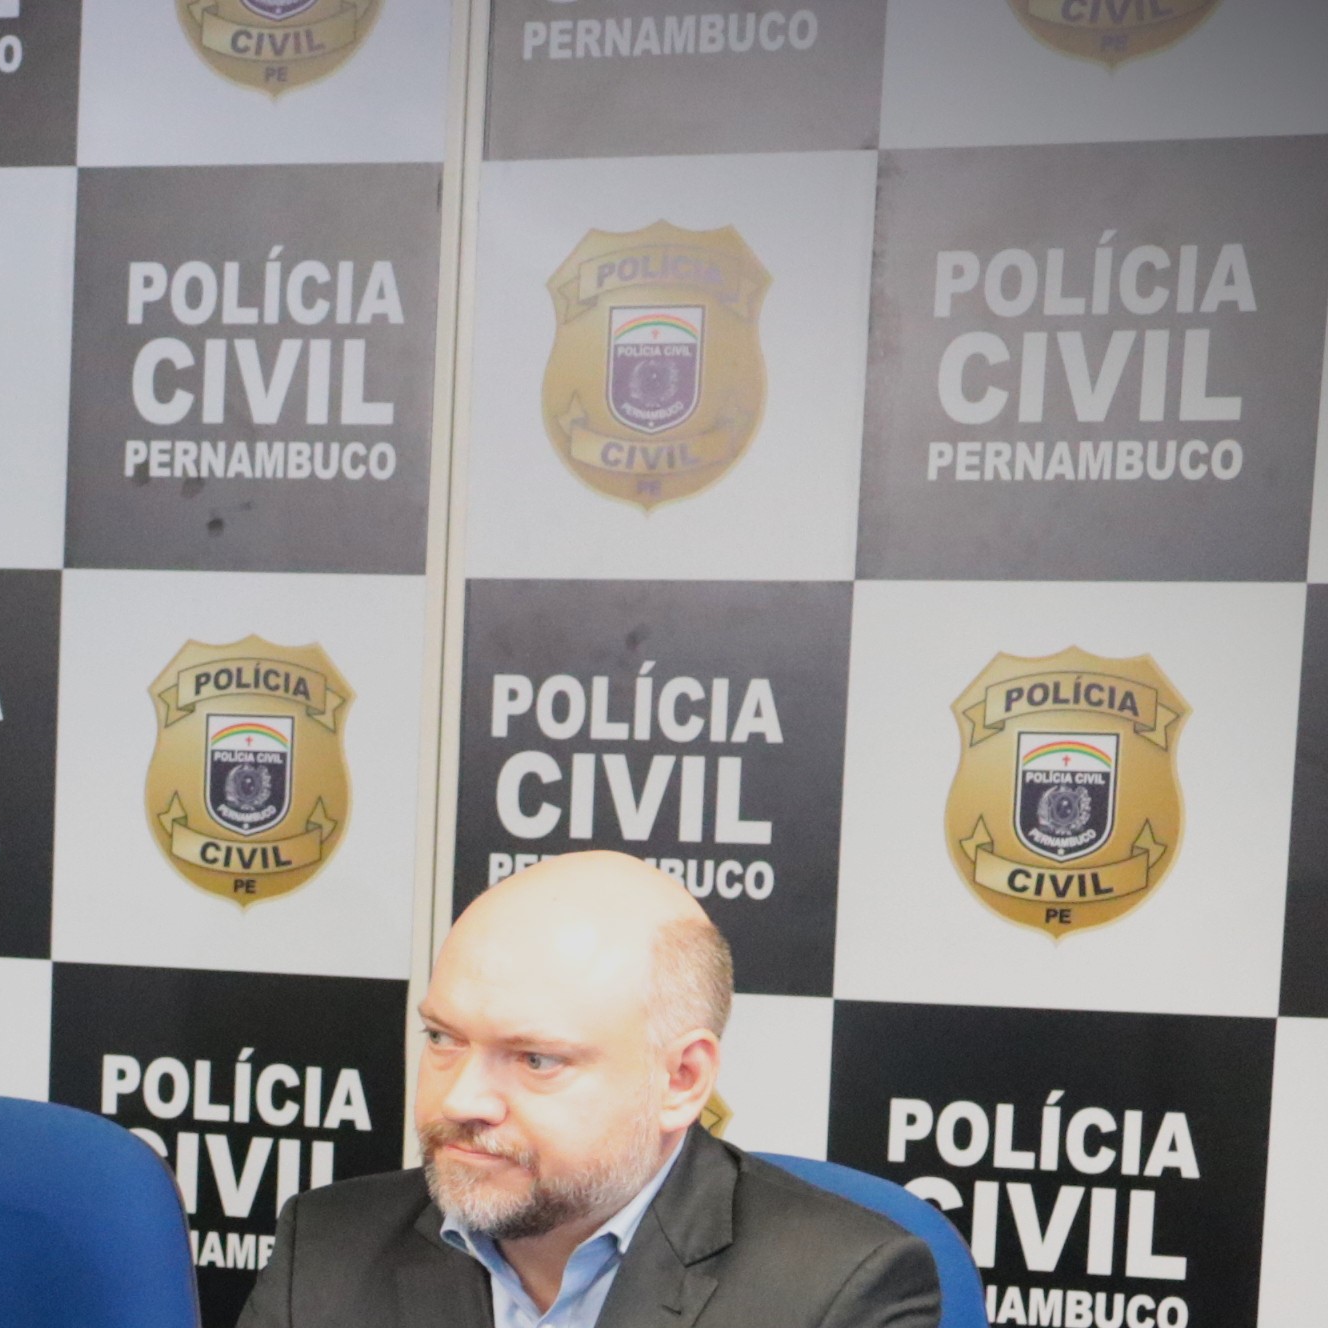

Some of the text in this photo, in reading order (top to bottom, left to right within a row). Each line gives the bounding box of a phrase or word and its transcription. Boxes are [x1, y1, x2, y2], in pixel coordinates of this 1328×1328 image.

[1061, 0, 1173, 25] CIVIL
[230, 28, 324, 57] CIVIL
[523, 11, 817, 60] PERNAMBUCO
[1100, 32, 1129, 54] PE
[263, 66, 288, 83] PE
[128, 245, 404, 325] POLÍCIA
[595, 254, 722, 287] POLÍCIA
[933, 230, 1258, 319] POLÍCIA
[616, 344, 692, 358] POLÍCIA CIVIL
[133, 338, 394, 425] CIVIL
[937, 328, 1243, 427] CIVIL
[125, 441, 396, 480] PERNAMBUCO
[600, 441, 701, 470] CIVIL
[927, 440, 1242, 481] PERNAMBUCO
[636, 480, 660, 495] PE
[194, 667, 310, 700] POLÍCIA
[1004, 676, 1139, 717] POLÍCIA
[492, 661, 783, 743] POLÍCIA
[214, 749, 282, 764] POLÍCIA CIVIL
[1026, 771, 1105, 785] POLÍCIA CIVIL
[497, 751, 772, 844] CIVIL
[200, 841, 292, 870] CIVIL
[233, 879, 256, 894] PE
[488, 853, 775, 901] PBUCO
[1007, 866, 1113, 898] CIVIL
[1045, 908, 1071, 924] PE
[102, 1048, 371, 1130] POLÍCIA
[888, 1090, 1199, 1178] POLÍCIA
